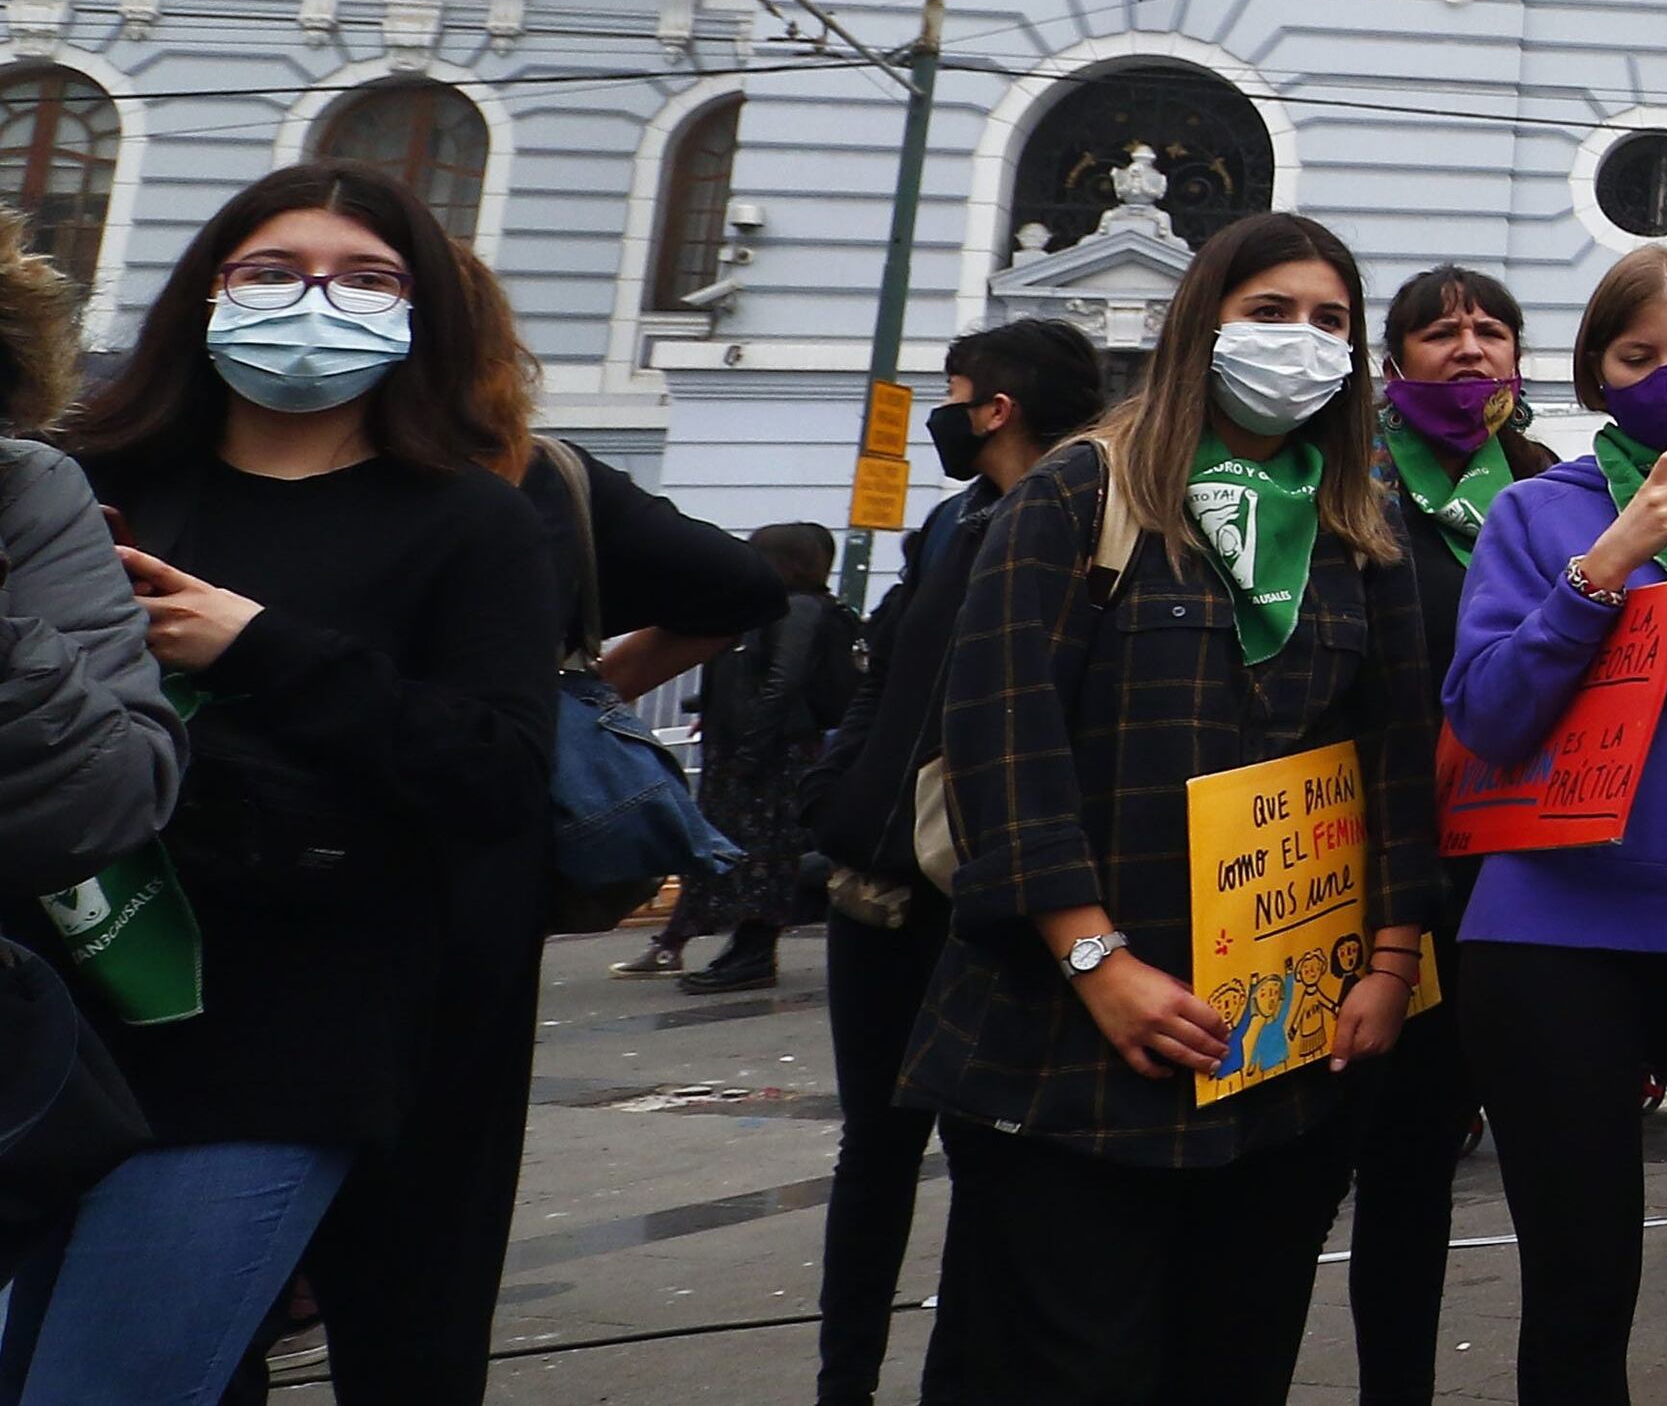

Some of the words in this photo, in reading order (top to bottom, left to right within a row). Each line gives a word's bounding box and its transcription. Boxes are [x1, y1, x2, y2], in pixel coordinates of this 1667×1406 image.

[1592, 623, 1660, 681] EORÍA
[1562, 730, 1587, 756] ES
[1600, 723, 1625, 749] LA
[1252, 790, 1290, 828] QUE
[1304, 763, 1355, 816] BACÁN
[1281, 831, 1308, 870] EL
[1255, 881, 1297, 931] NOS
[1305, 863, 1356, 912] une
